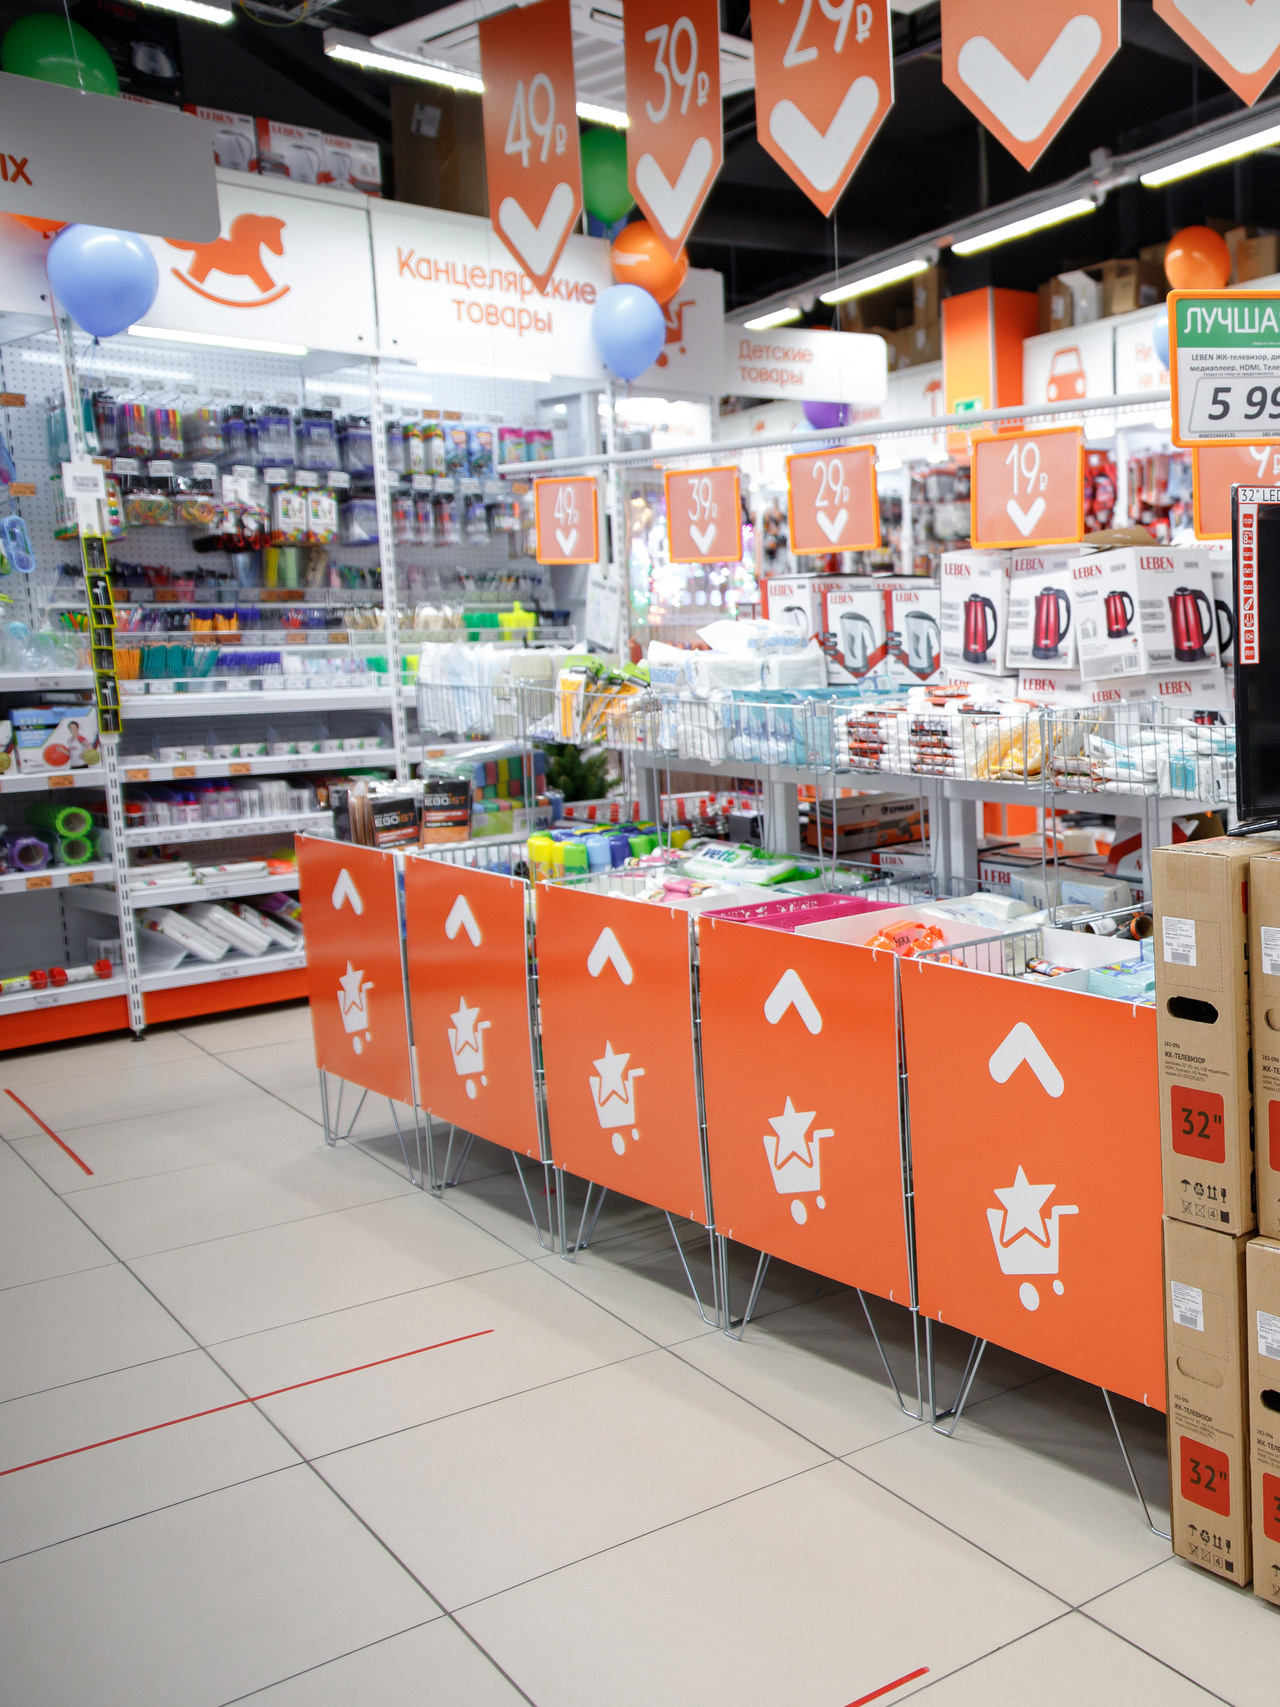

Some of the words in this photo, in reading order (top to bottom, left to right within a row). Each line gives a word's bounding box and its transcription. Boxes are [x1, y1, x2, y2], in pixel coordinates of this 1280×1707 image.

[452, 298, 553, 337] товары
[738, 339, 813, 363] Детские
[1239, 364, 1261, 372] HDMI,
[738, 364, 804, 387] товары
[1207, 386, 1232, 421] 5
[1241, 489, 1260, 502] 32"
[945, 563, 971, 576] LEBEN
[1015, 558, 1044, 572] LEBEN
[1140, 556, 1174, 570] LEBEN
[1073, 564, 1102, 580] LEBEN
[770, 584, 793, 597] LEBEN
[896, 592, 919, 602] LEBEN
[830, 593, 853, 604] LEBEN
[1023, 677, 1055, 692] LEBEN
[1159, 680, 1192, 696] LEBEN
[1092, 689, 1121, 703] LEBEN
[1164, 1051, 1206, 1064] ЖК-ТЕЛЕВИЗОР
[1181, 1107, 1222, 1140] 32"
[1174, 1403, 1213, 1423] ЖК-ТЕЛЕВИЗОР
[1189, 1458, 1228, 1493] 32"
